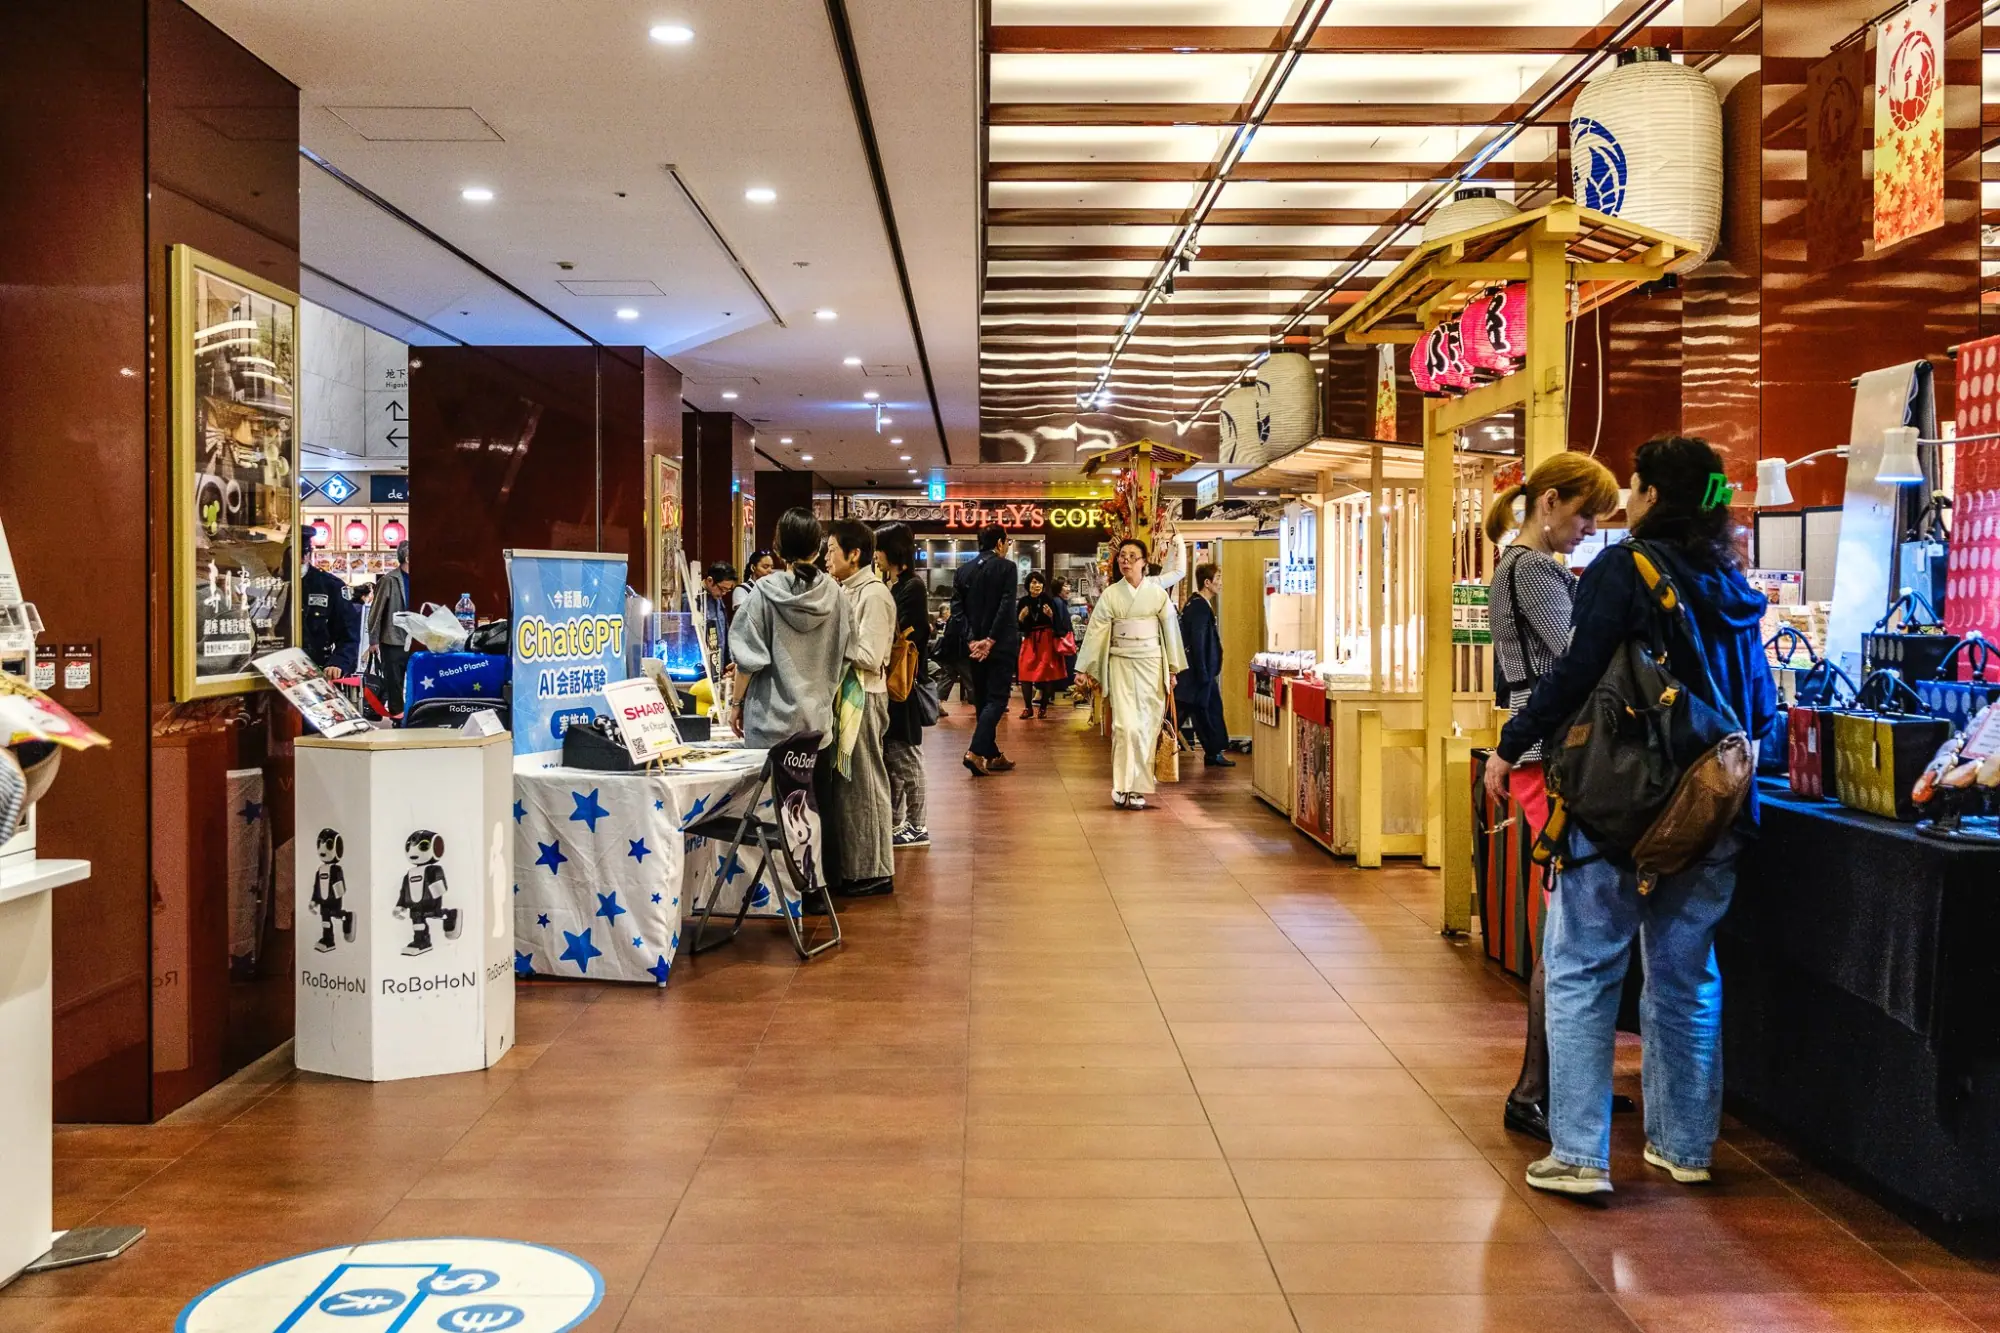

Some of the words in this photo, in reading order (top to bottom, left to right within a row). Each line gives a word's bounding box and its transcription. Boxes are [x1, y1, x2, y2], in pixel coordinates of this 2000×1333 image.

[518, 618, 623, 658] ChatGPT
[439, 664, 463, 678] Robot
[463, 659, 489, 673] Planet
[624, 702, 665, 720] SHARP
[302, 970, 366, 994] RoBoHoN
[382, 971, 476, 995] RoBoHoN
